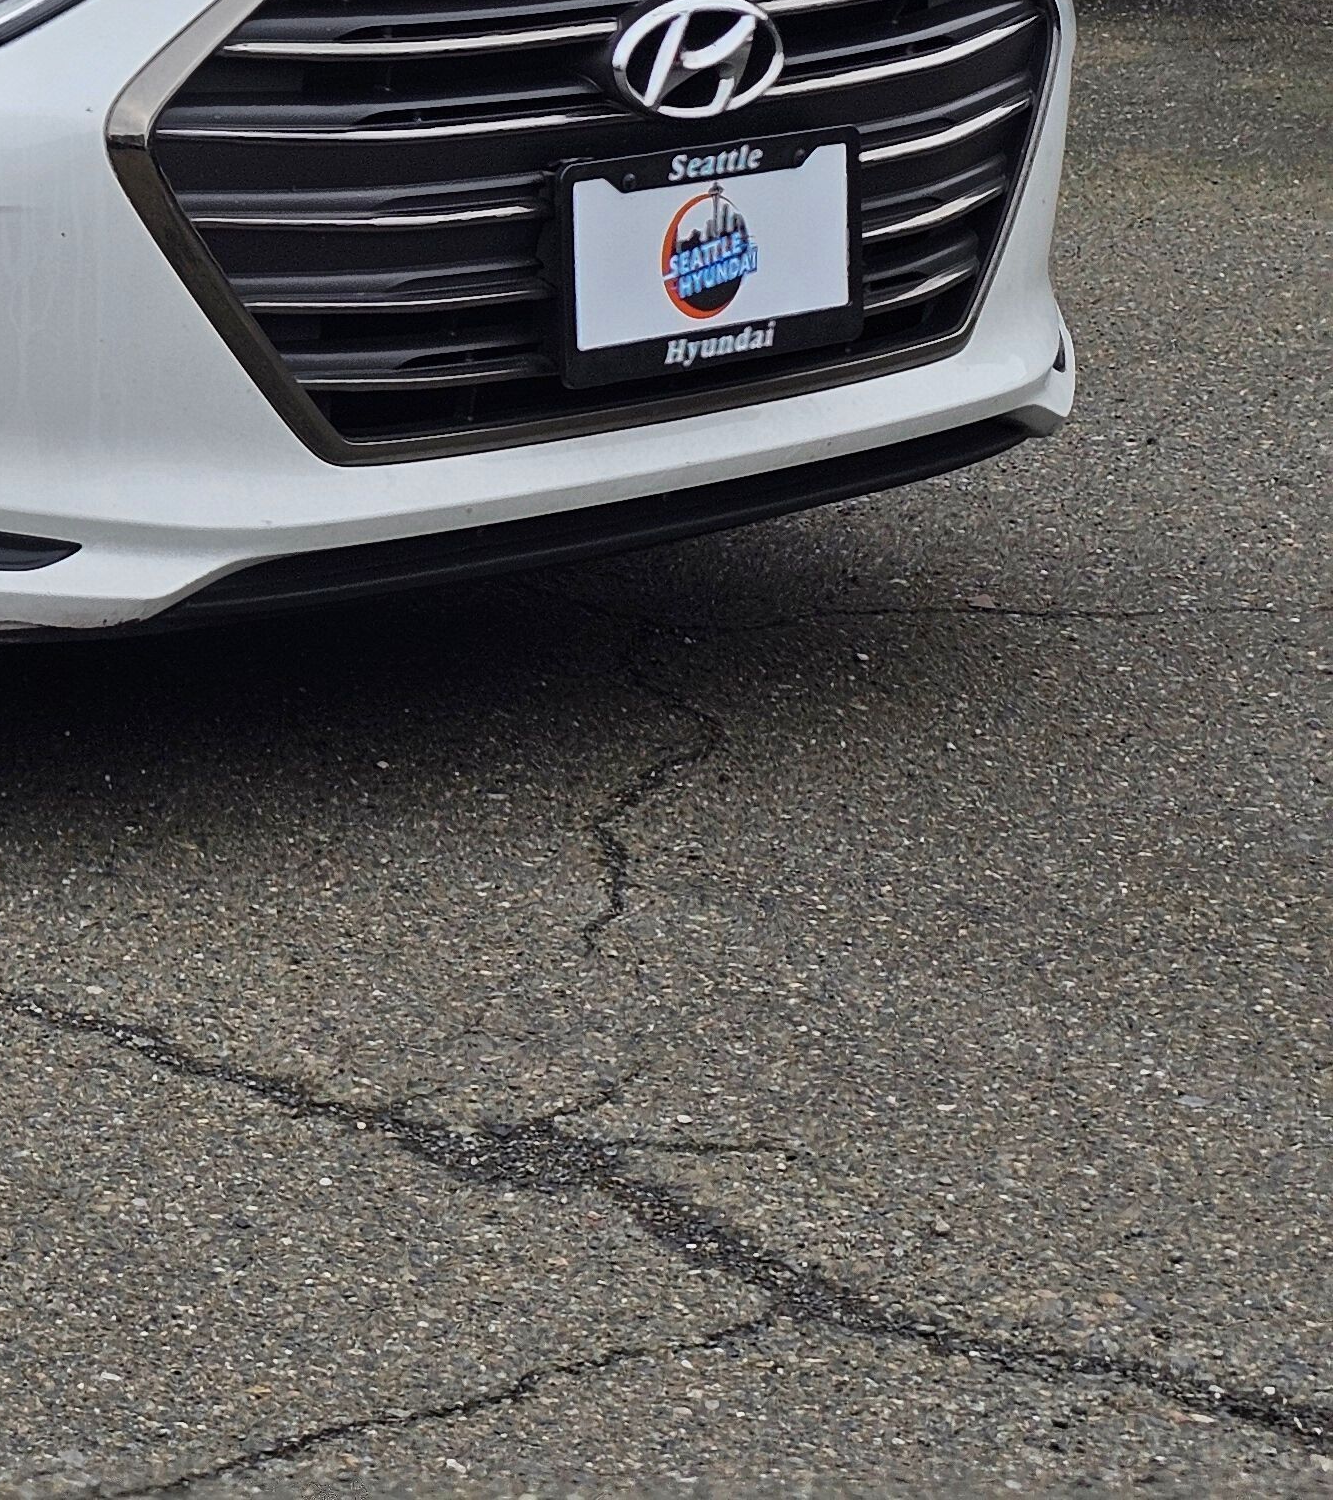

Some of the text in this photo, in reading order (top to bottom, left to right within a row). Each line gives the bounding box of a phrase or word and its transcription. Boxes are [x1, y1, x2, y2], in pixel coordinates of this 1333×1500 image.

[667, 143, 764, 182] Seattle
[669, 231, 749, 276] SEATTLE
[677, 249, 758, 299] HYUNDAI
[664, 320, 777, 367] Hyundai
